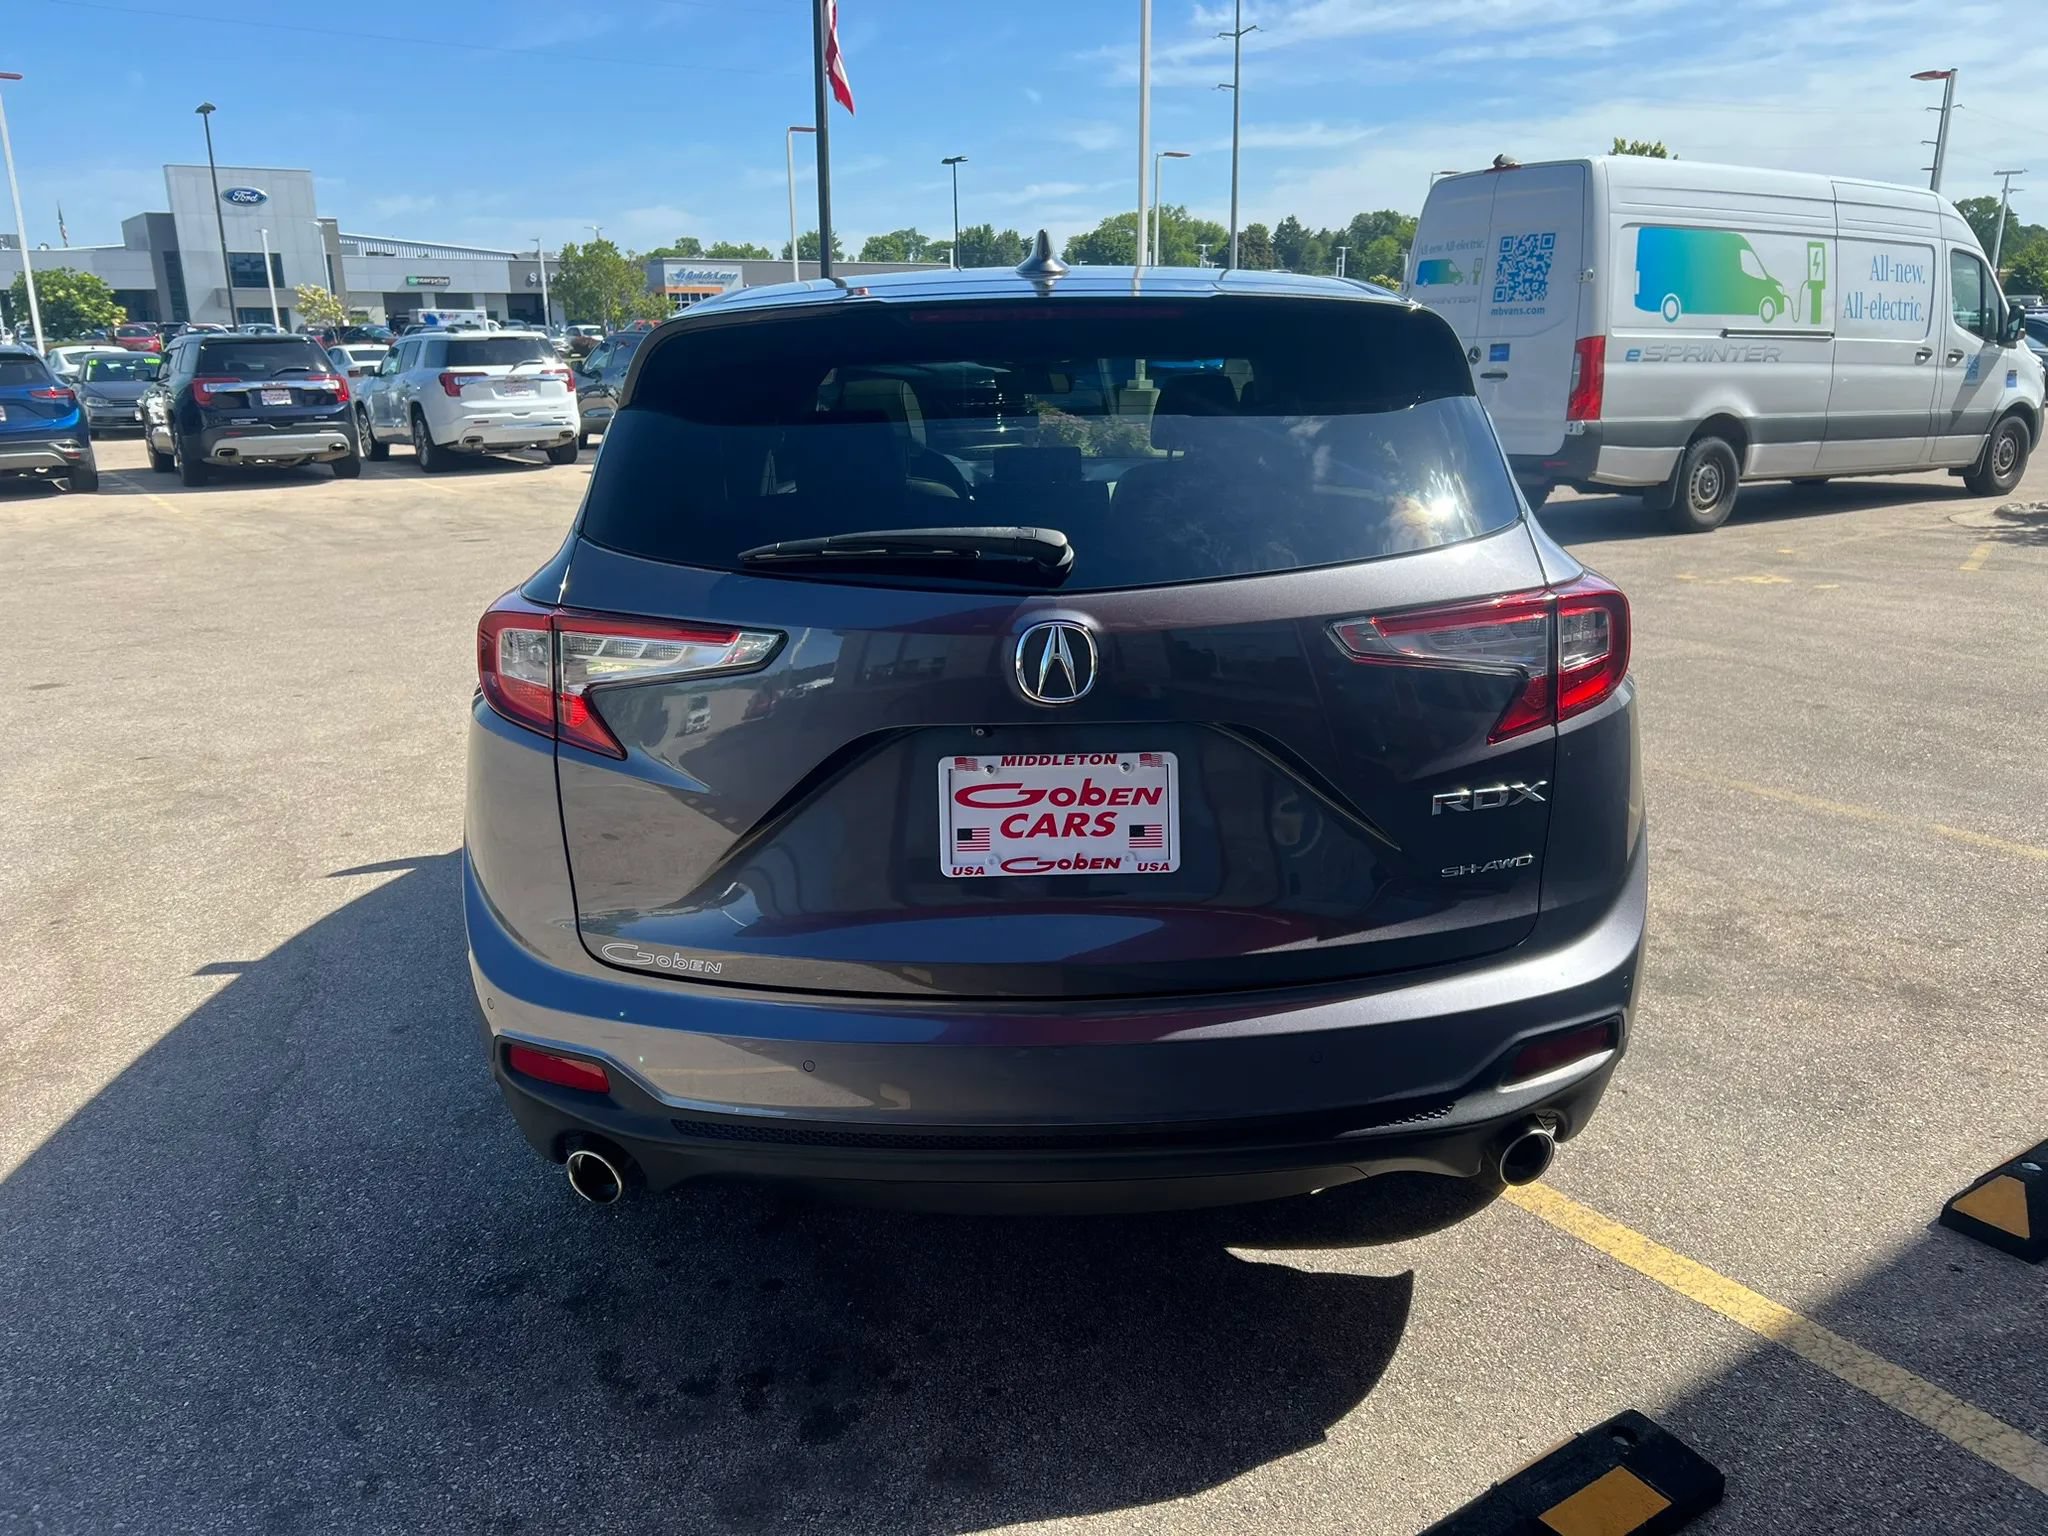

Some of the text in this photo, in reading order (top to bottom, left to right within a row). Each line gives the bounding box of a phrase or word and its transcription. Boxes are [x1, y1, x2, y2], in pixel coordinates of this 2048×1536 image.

[232, 190, 258, 202] Ford
[1870, 254, 1926, 284] All-new.
[1491, 306, 1545, 316] mbvans.com
[1843, 291, 1925, 321] All-electric.
[1625, 344, 1783, 362] eSPRINTER
[1001, 754, 1117, 767] MIDDLETON
[1432, 780, 1548, 815] RDX
[1000, 811, 1118, 839] CARS
[952, 866, 985, 876] USA
[1137, 862, 1171, 872] USA
[1441, 854, 1535, 878] SH-AWD
